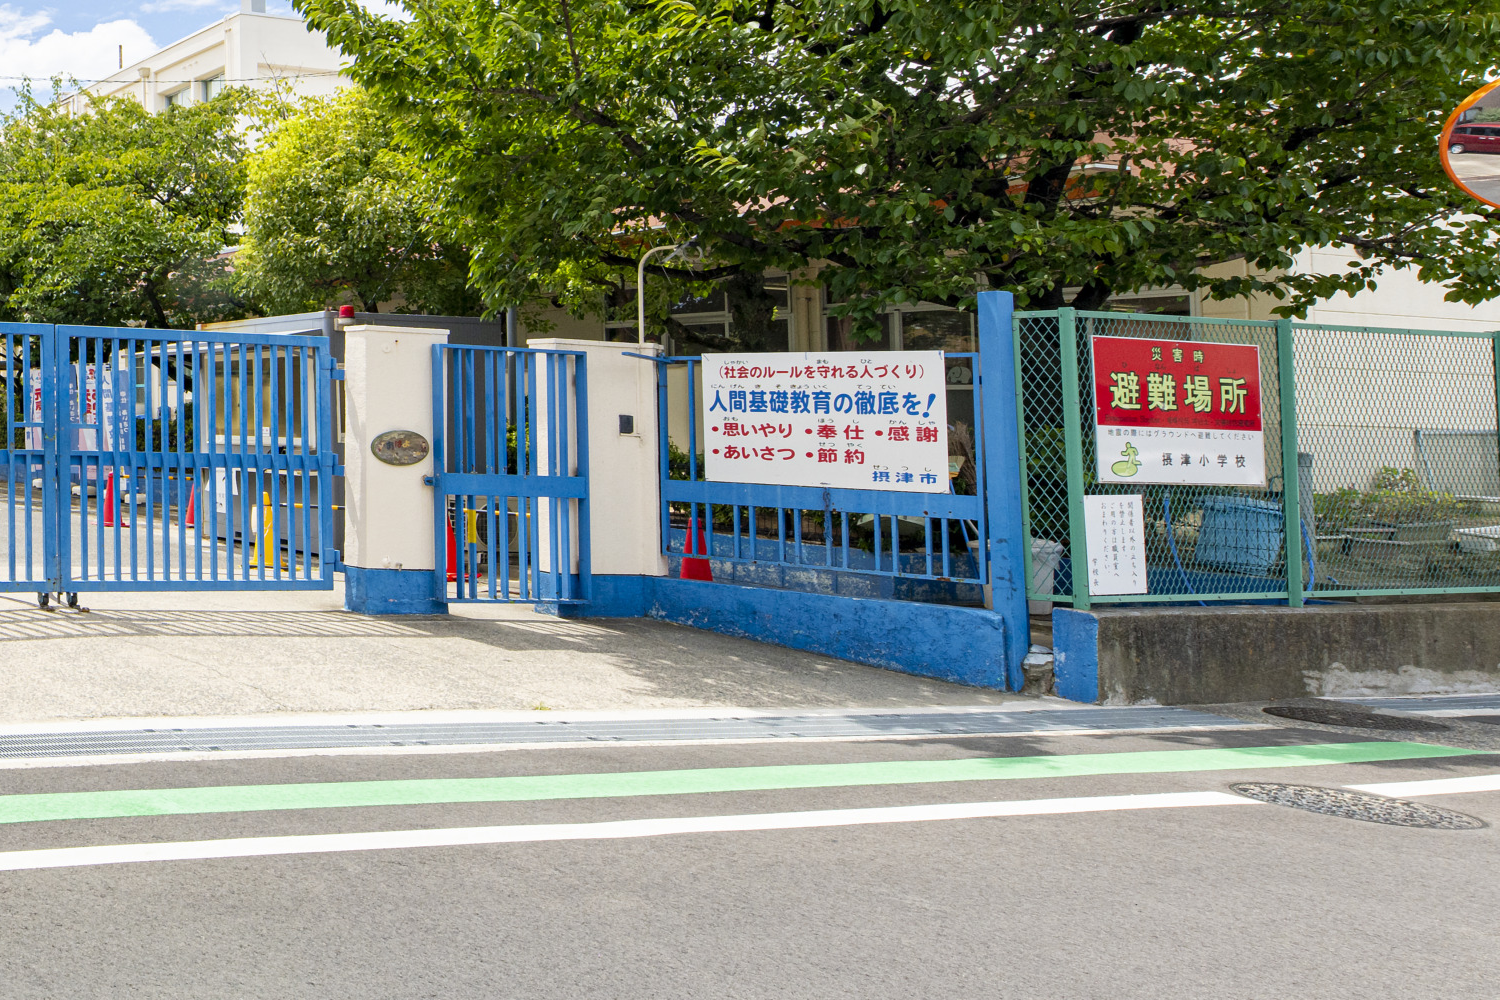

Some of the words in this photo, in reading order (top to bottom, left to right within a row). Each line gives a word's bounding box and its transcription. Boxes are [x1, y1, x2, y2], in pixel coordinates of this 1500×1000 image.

[1151, 346, 1204, 363] 災害時
[1109, 370, 1248, 414] 避難場所
[723, 422, 793, 438] 思いやり
[817, 424, 865, 440] 奉仕
[888, 426, 938, 442] 感謝
[1107, 428, 1255, 441] 地震の際にはグラウンドへ避難してください
[724, 445, 796, 461] あいさつ
[817, 448, 865, 464] 節約
[1162, 452, 1246, 468] 摂津小学校
[872, 471, 937, 484] 摂津市
